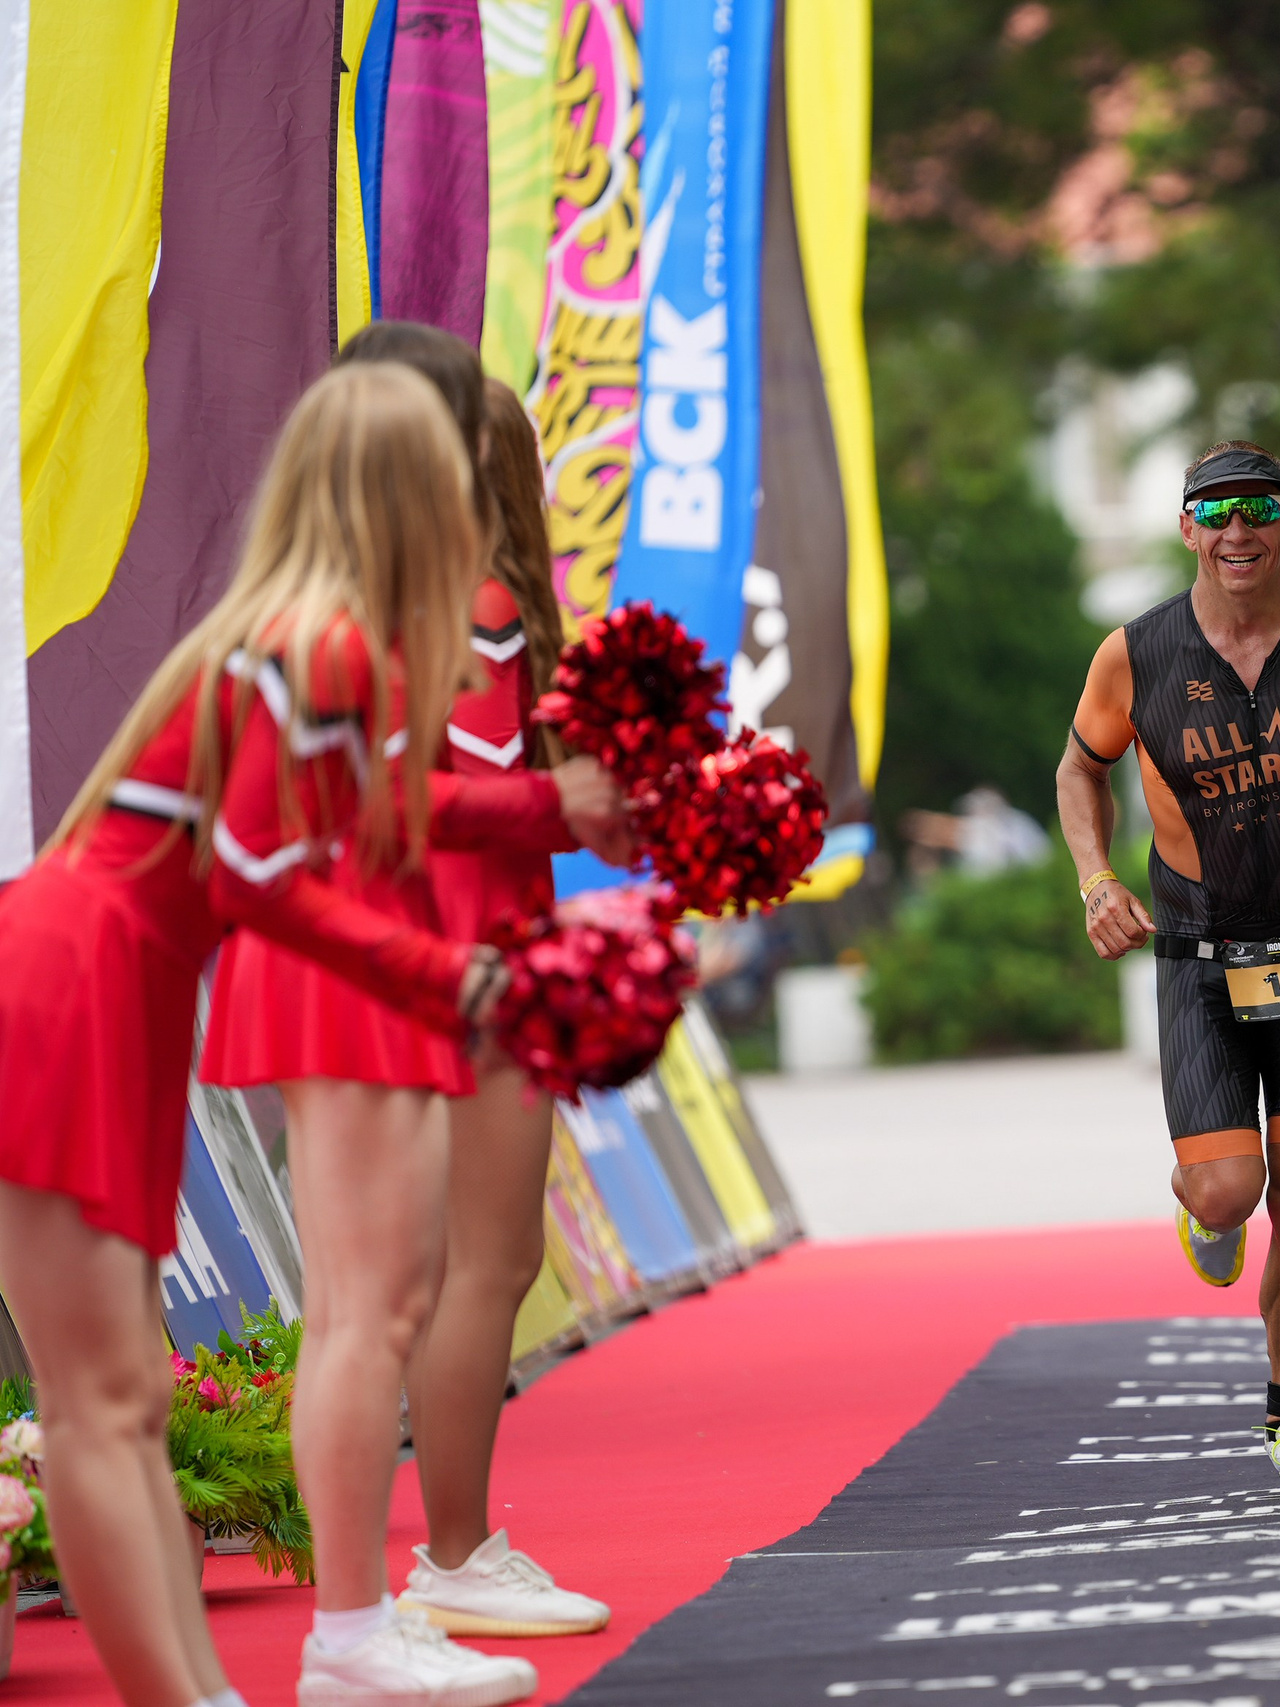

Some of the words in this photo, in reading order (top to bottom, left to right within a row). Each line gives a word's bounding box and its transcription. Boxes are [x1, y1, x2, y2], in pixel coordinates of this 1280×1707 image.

[638, 294, 728, 551] ВСК
[1183, 723, 1253, 763] ALL
[1203, 807, 1222, 819] BY
